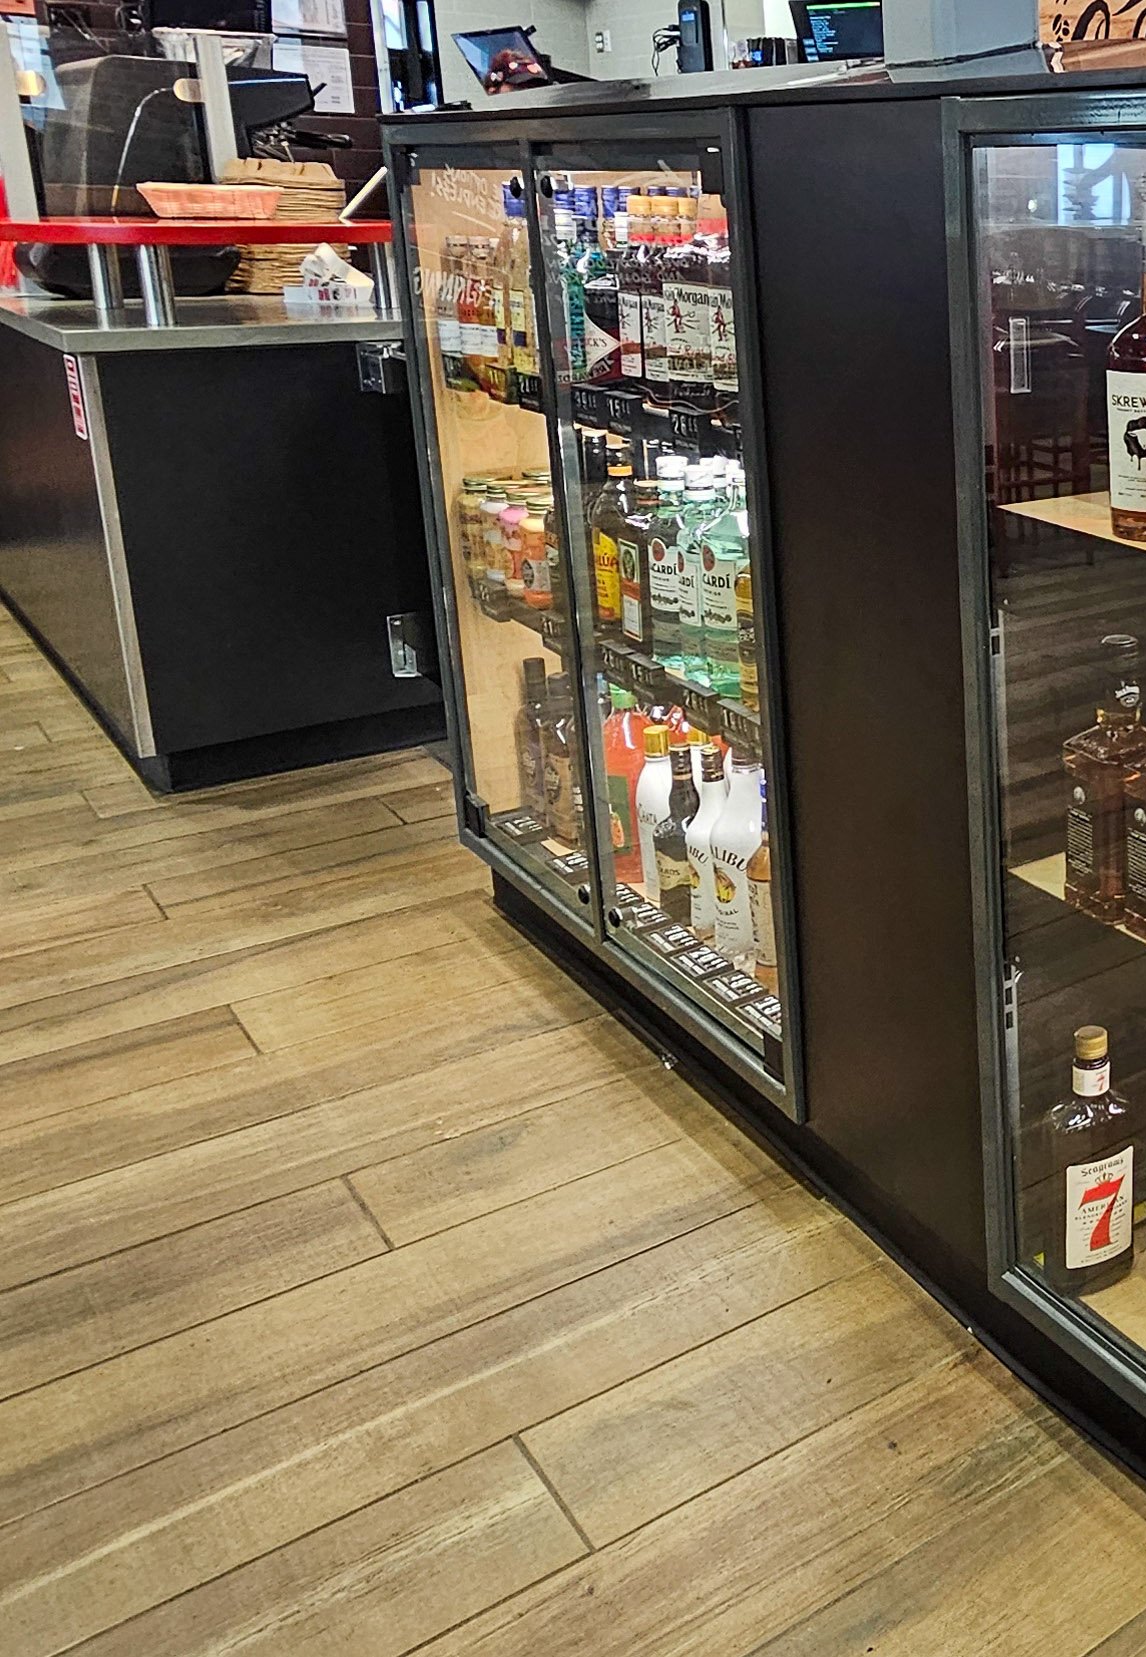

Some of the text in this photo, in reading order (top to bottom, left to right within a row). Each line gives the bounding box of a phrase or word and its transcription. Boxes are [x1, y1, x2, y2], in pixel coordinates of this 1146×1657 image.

[651, 562, 678, 576] CARDÍ
[702, 572, 732, 589] CARDÍ
[711, 844, 748, 873] LIBU
[1077, 1174, 1126, 1252] 7
